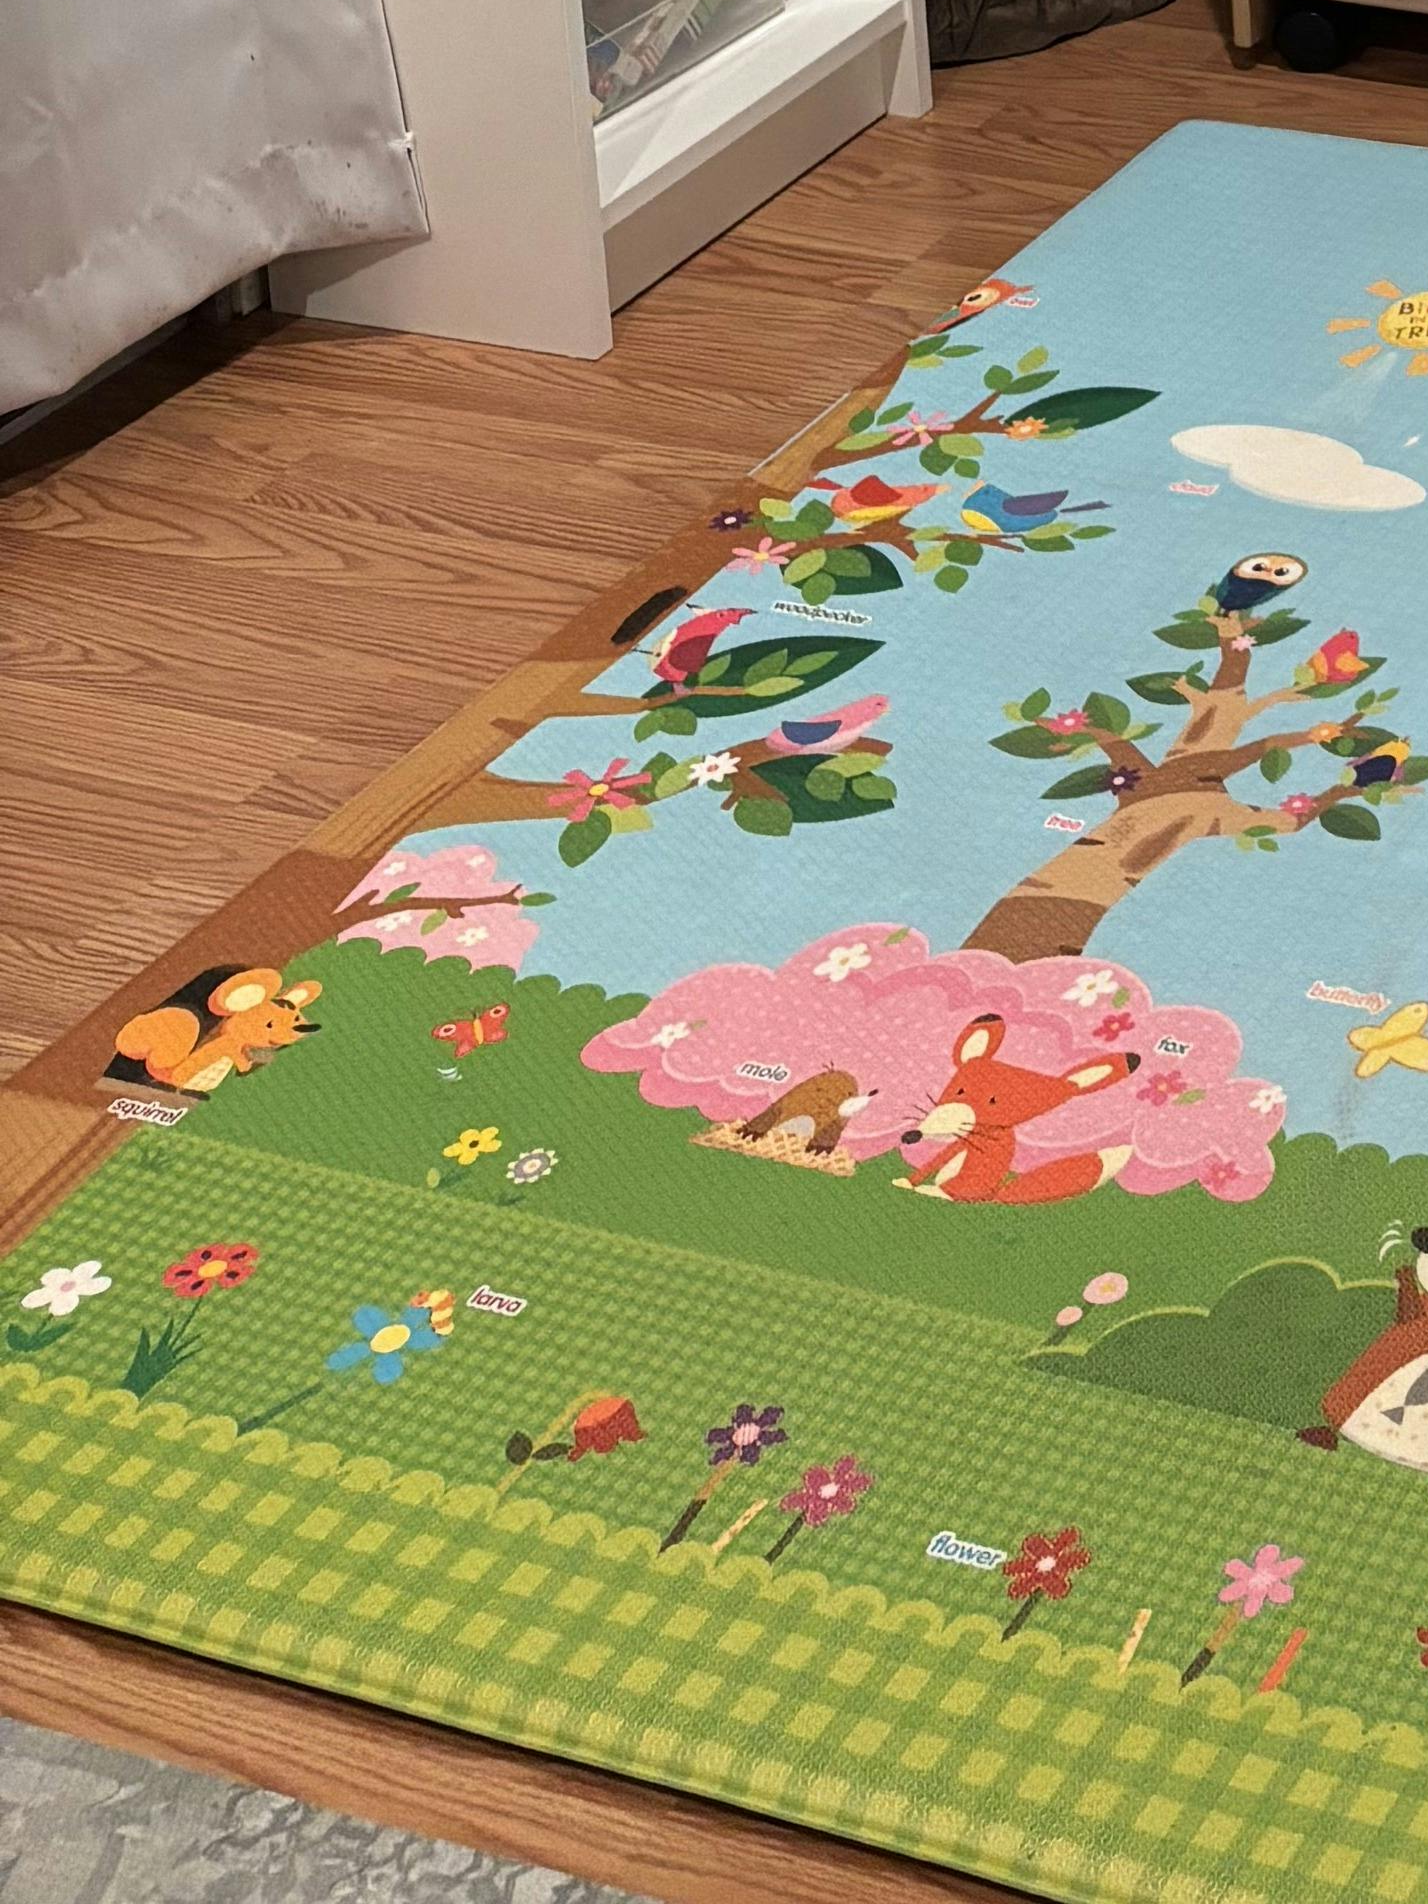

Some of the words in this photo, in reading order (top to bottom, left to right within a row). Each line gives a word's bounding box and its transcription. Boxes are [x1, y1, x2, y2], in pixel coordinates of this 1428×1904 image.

[1157, 1036, 1190, 1054] fox
[740, 1063, 788, 1081] mole
[470, 1288, 522, 1312] larva
[930, 1534, 1002, 1565] flower
